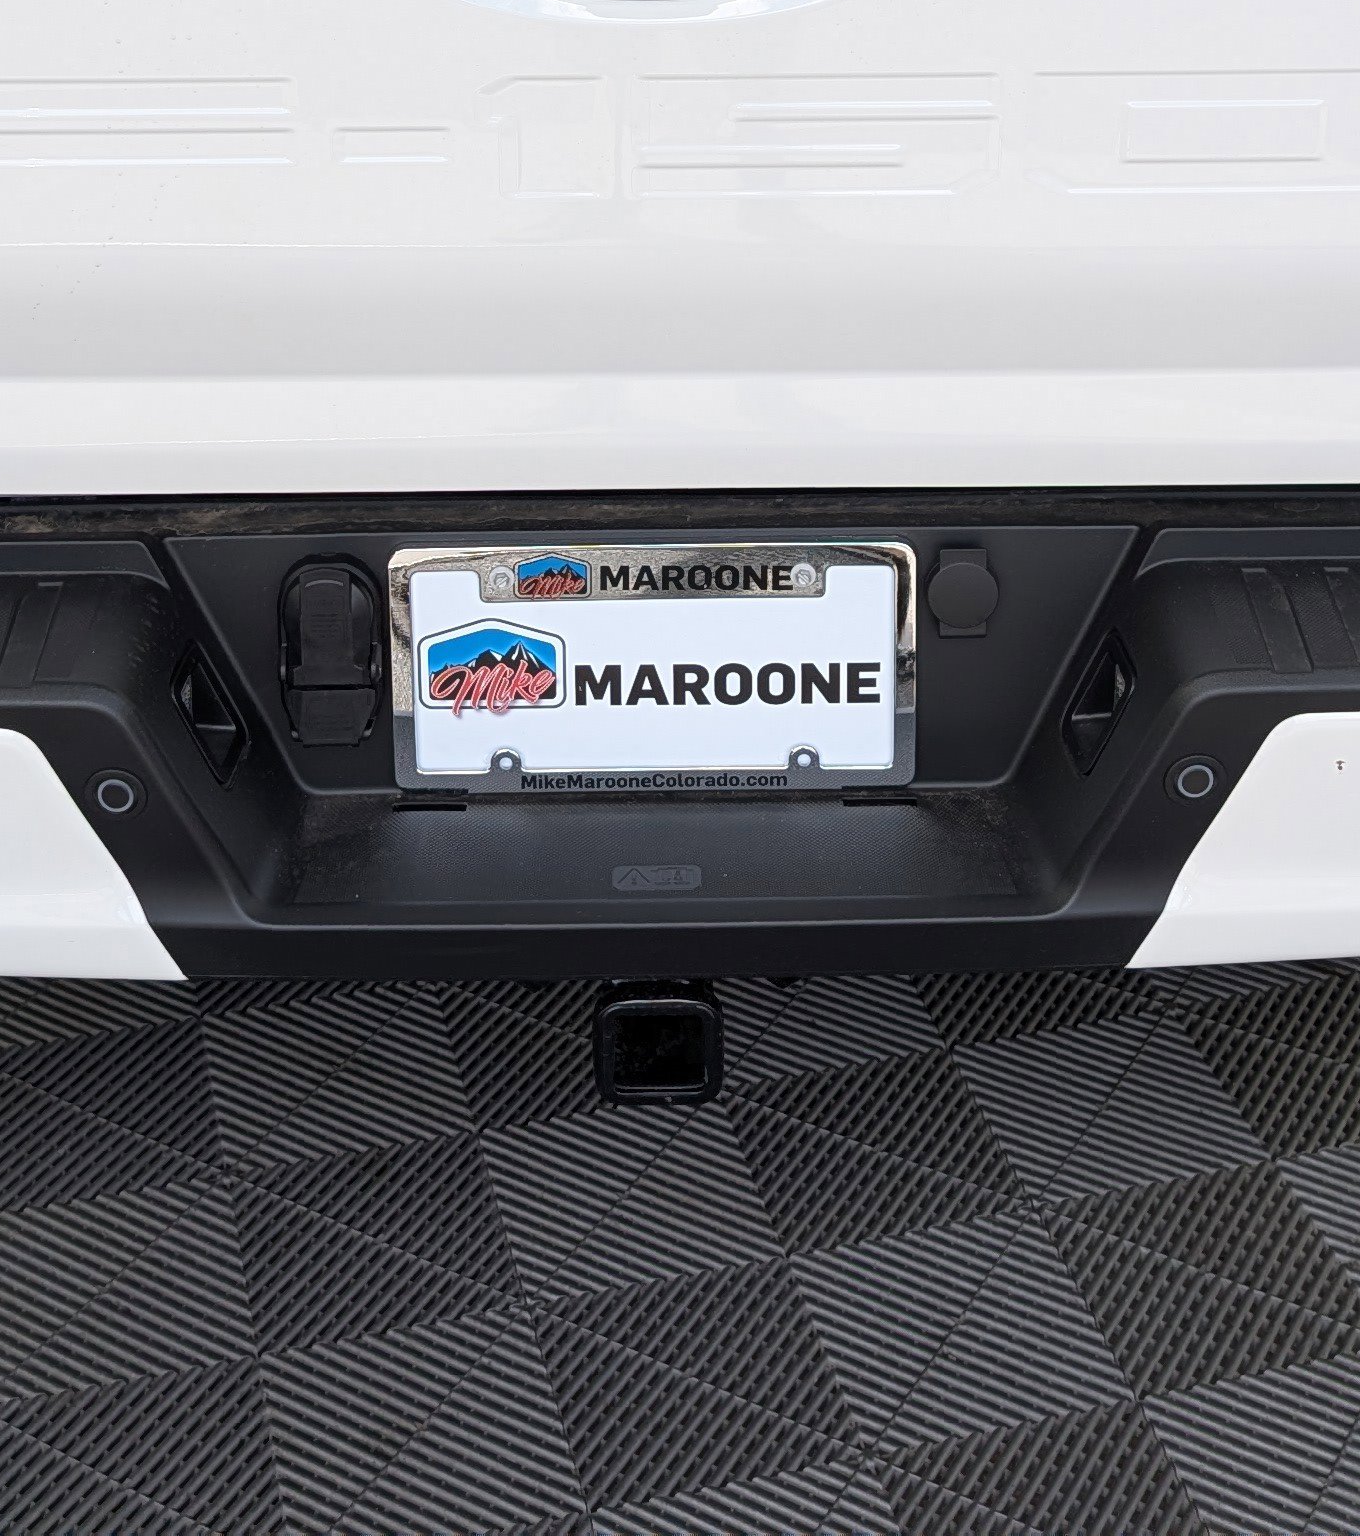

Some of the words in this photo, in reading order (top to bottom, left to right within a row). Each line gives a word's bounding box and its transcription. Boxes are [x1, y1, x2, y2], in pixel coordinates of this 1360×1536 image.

[520, 572, 586, 600] Mike
[599, 563, 794, 592] MAROONE
[430, 659, 556, 716] Mike
[574, 662, 882, 707] MAROONE
[520, 771, 788, 791] MikeMarooneColorado.com
